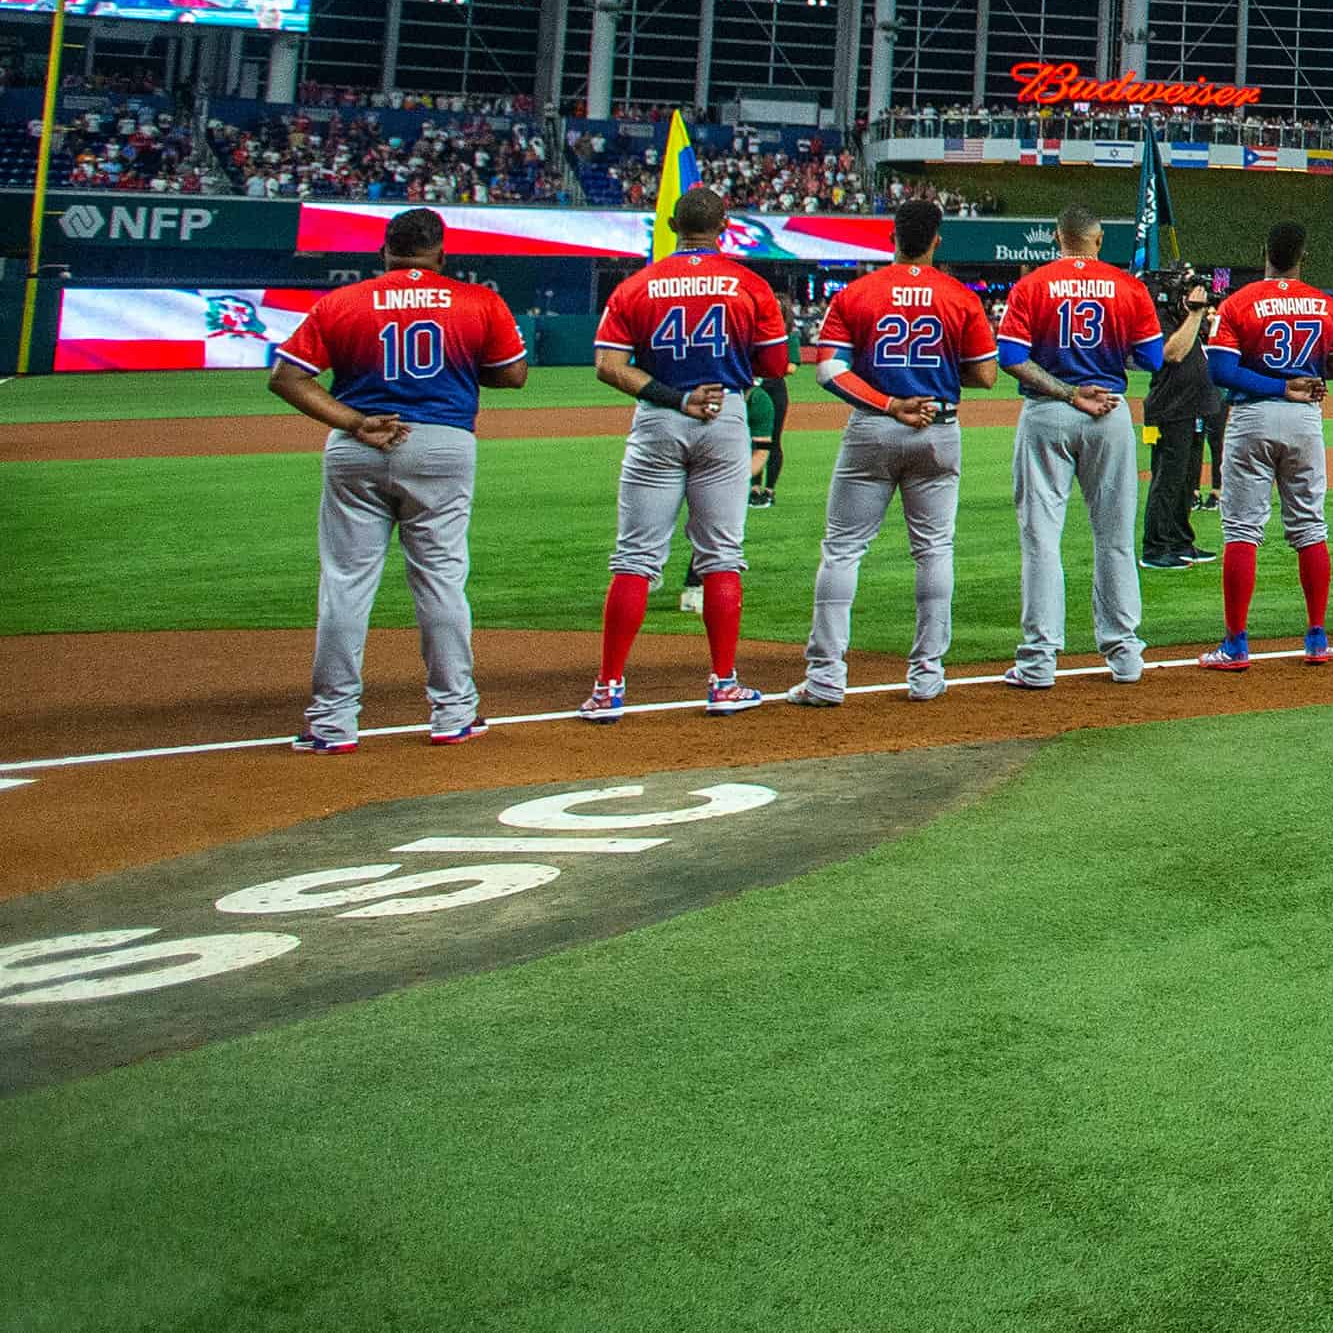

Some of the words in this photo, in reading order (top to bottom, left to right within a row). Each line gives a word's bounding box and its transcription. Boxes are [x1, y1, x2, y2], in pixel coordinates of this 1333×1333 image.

[1010, 61, 1262, 107] Budweiser
[109, 206, 213, 241] NFP
[995, 245, 1062, 261] Budweis
[373, 288, 452, 310] LINARES
[647, 276, 739, 299] RODRIGUEZ
[891, 286, 933, 307] SOTO
[1048, 279, 1115, 298] MACHADO
[1254, 297, 1329, 318] HERNANDEZ
[651, 303, 729, 360] 44
[874, 314, 943, 368] 22
[1057, 299, 1105, 348] 13
[379, 319, 444, 381] 10
[1263, 320, 1322, 369] 37
[0, 782, 778, 1006] SSIC
